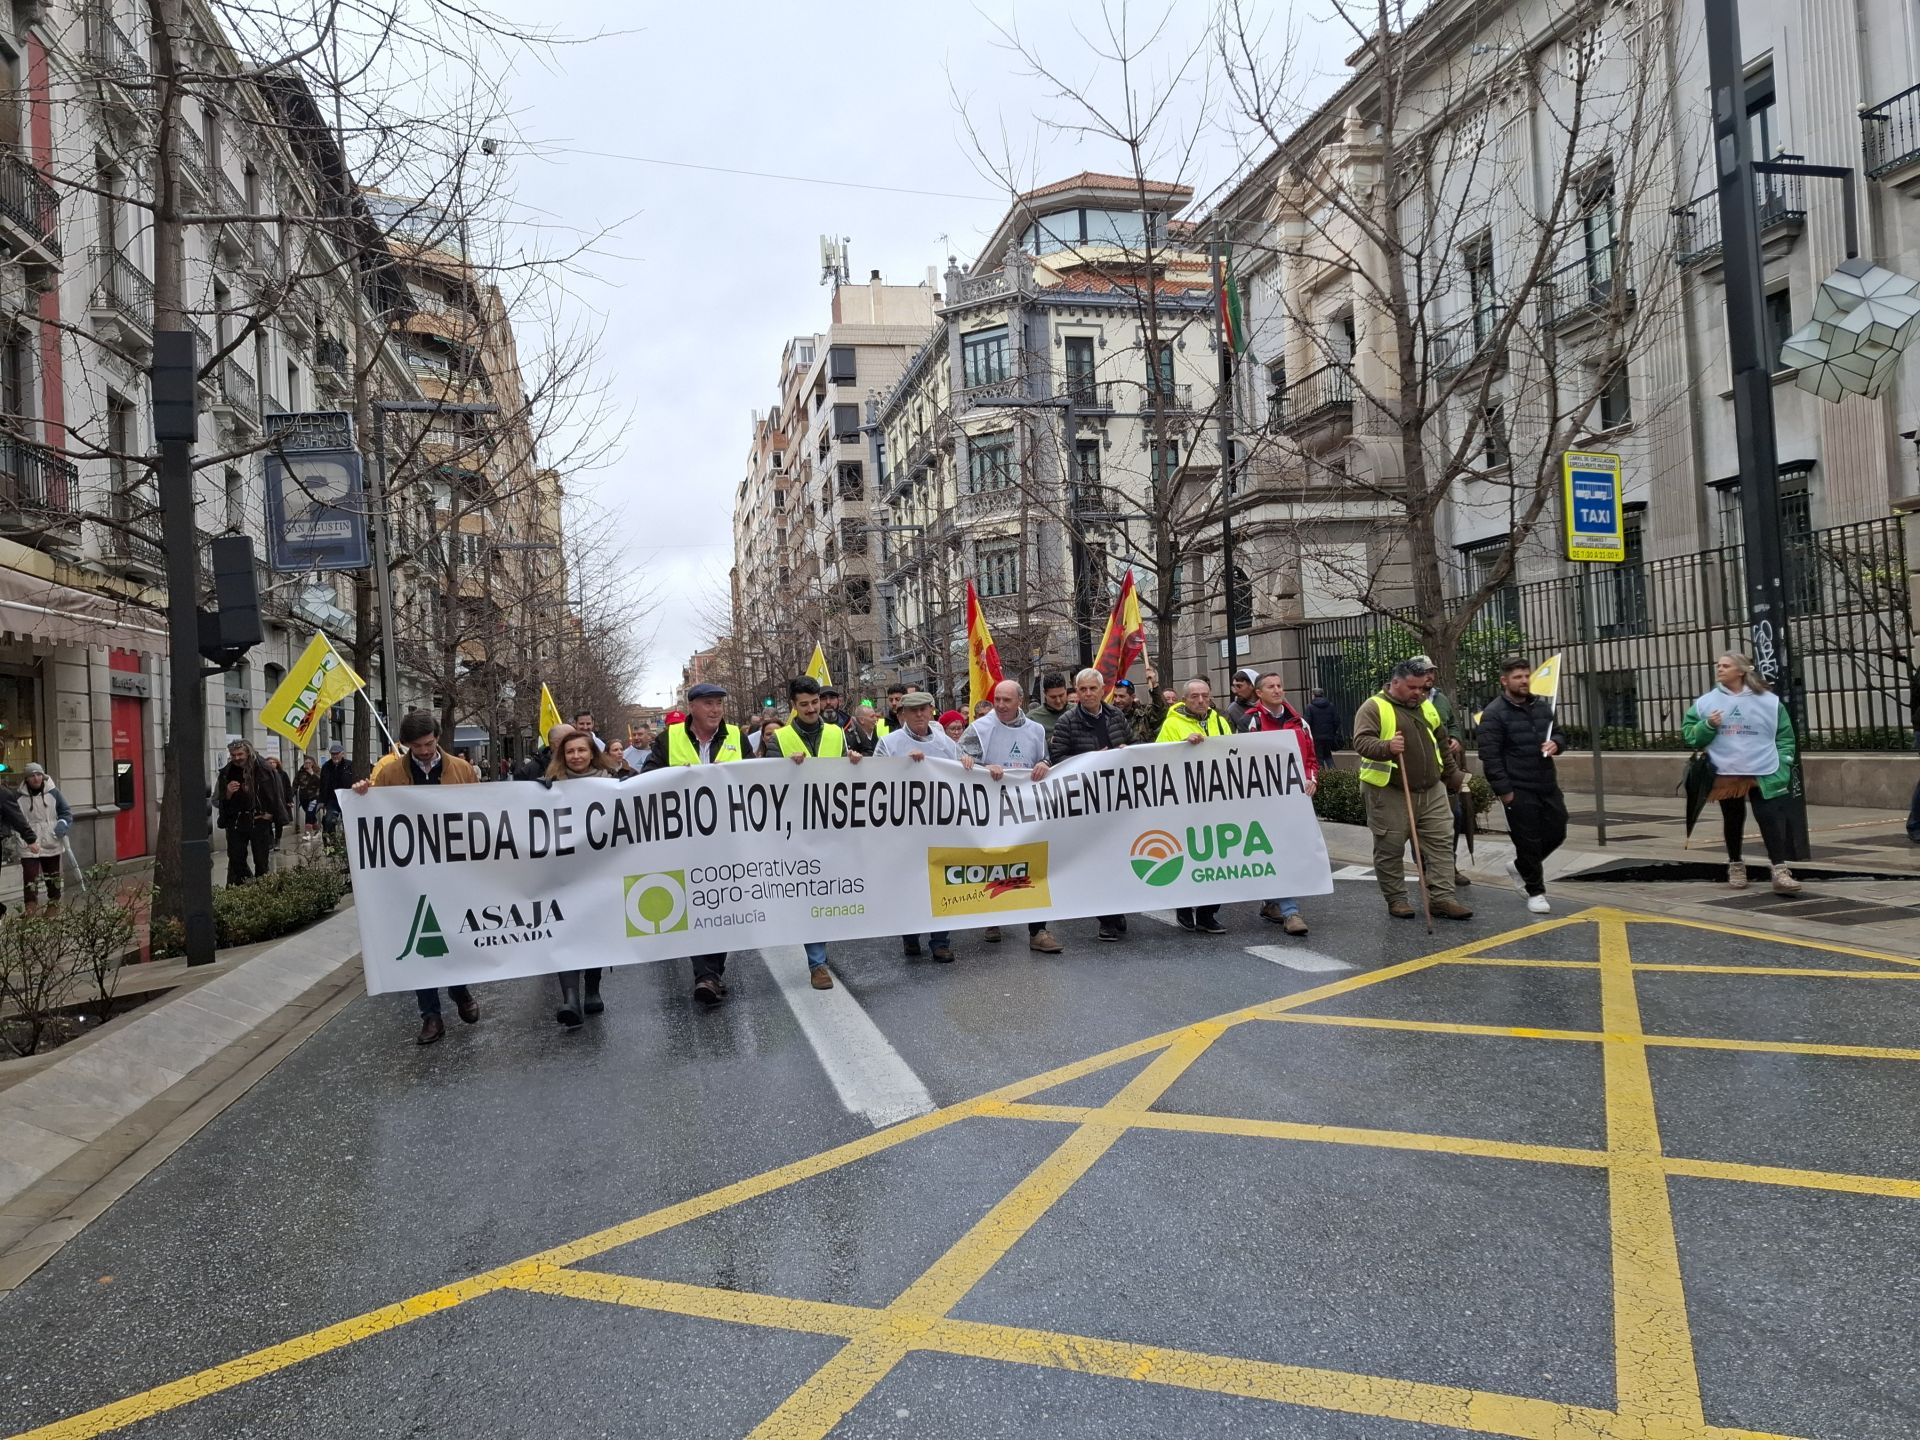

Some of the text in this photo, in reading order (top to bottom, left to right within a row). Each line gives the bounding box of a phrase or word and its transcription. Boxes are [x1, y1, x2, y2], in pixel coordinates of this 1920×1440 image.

[310, 433, 349, 448] HORAS
[1580, 508, 1611, 524] TAXI
[357, 747, 1306, 870] MONEDA DE CAMBIO HOY, INSEGURIDAD ALIMENTARIA MAÑANA
[1186, 820, 1274, 862] UPA
[690, 857, 821, 884] cooperativas
[945, 863, 1028, 884] COAG
[1190, 861, 1277, 884] GRANADA
[692, 876, 865, 910] agro-alimentarias
[940, 888, 986, 913] Granada
[458, 899, 565, 934] ASAJA
[693, 902, 865, 930] Andalucía Granada
[473, 928, 553, 948] GRANADA
